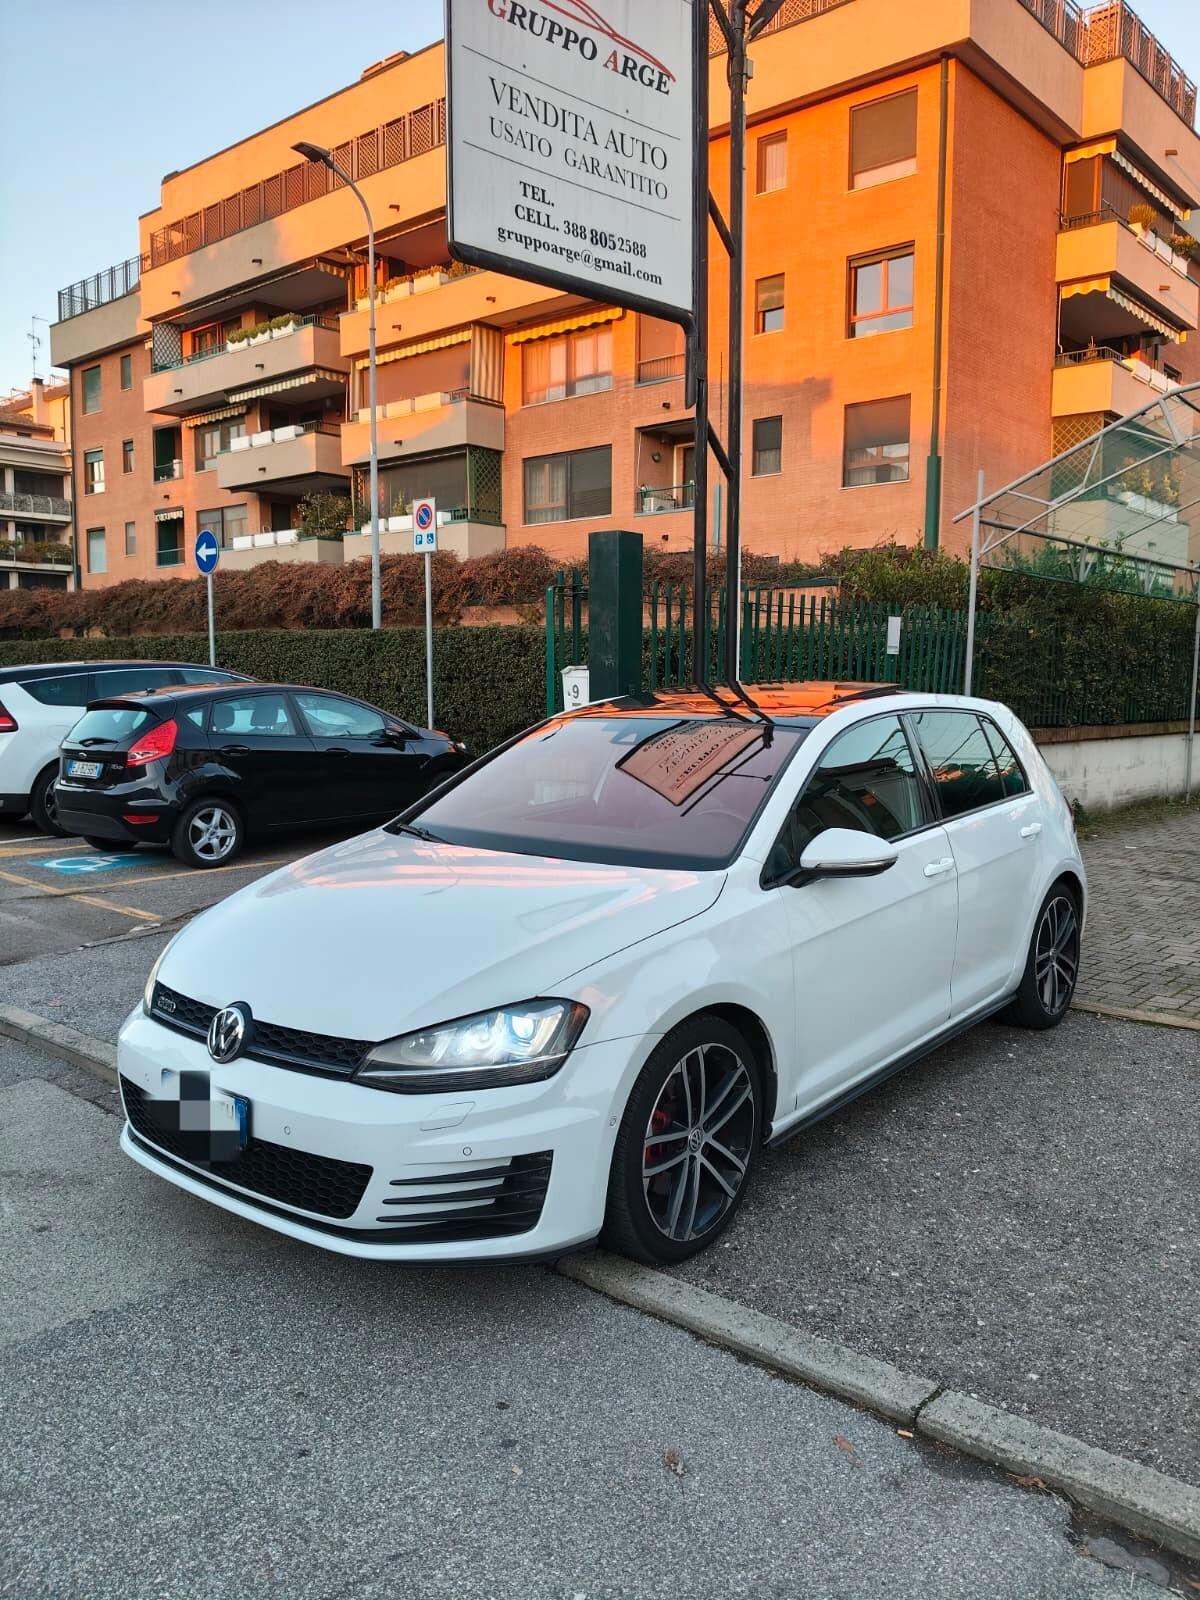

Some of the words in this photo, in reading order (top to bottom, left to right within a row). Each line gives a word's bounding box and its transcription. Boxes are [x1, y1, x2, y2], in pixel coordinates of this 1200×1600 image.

[487, 0, 598, 61] GRUPPO
[603, 50, 671, 95] ARGE
[488, 76, 599, 146] VENDITA
[604, 128, 667, 170] AUTO
[489, 116, 552, 158] USATO
[564, 148, 668, 200] GARANTITO
[514, 204, 560, 232] CELL.
[563, 220, 587, 240] 388
[519, 181, 555, 208] TEL.
[497, 227, 663, 286] gruppoarge@gmail.com
[572, 684, 580, 700] 9
